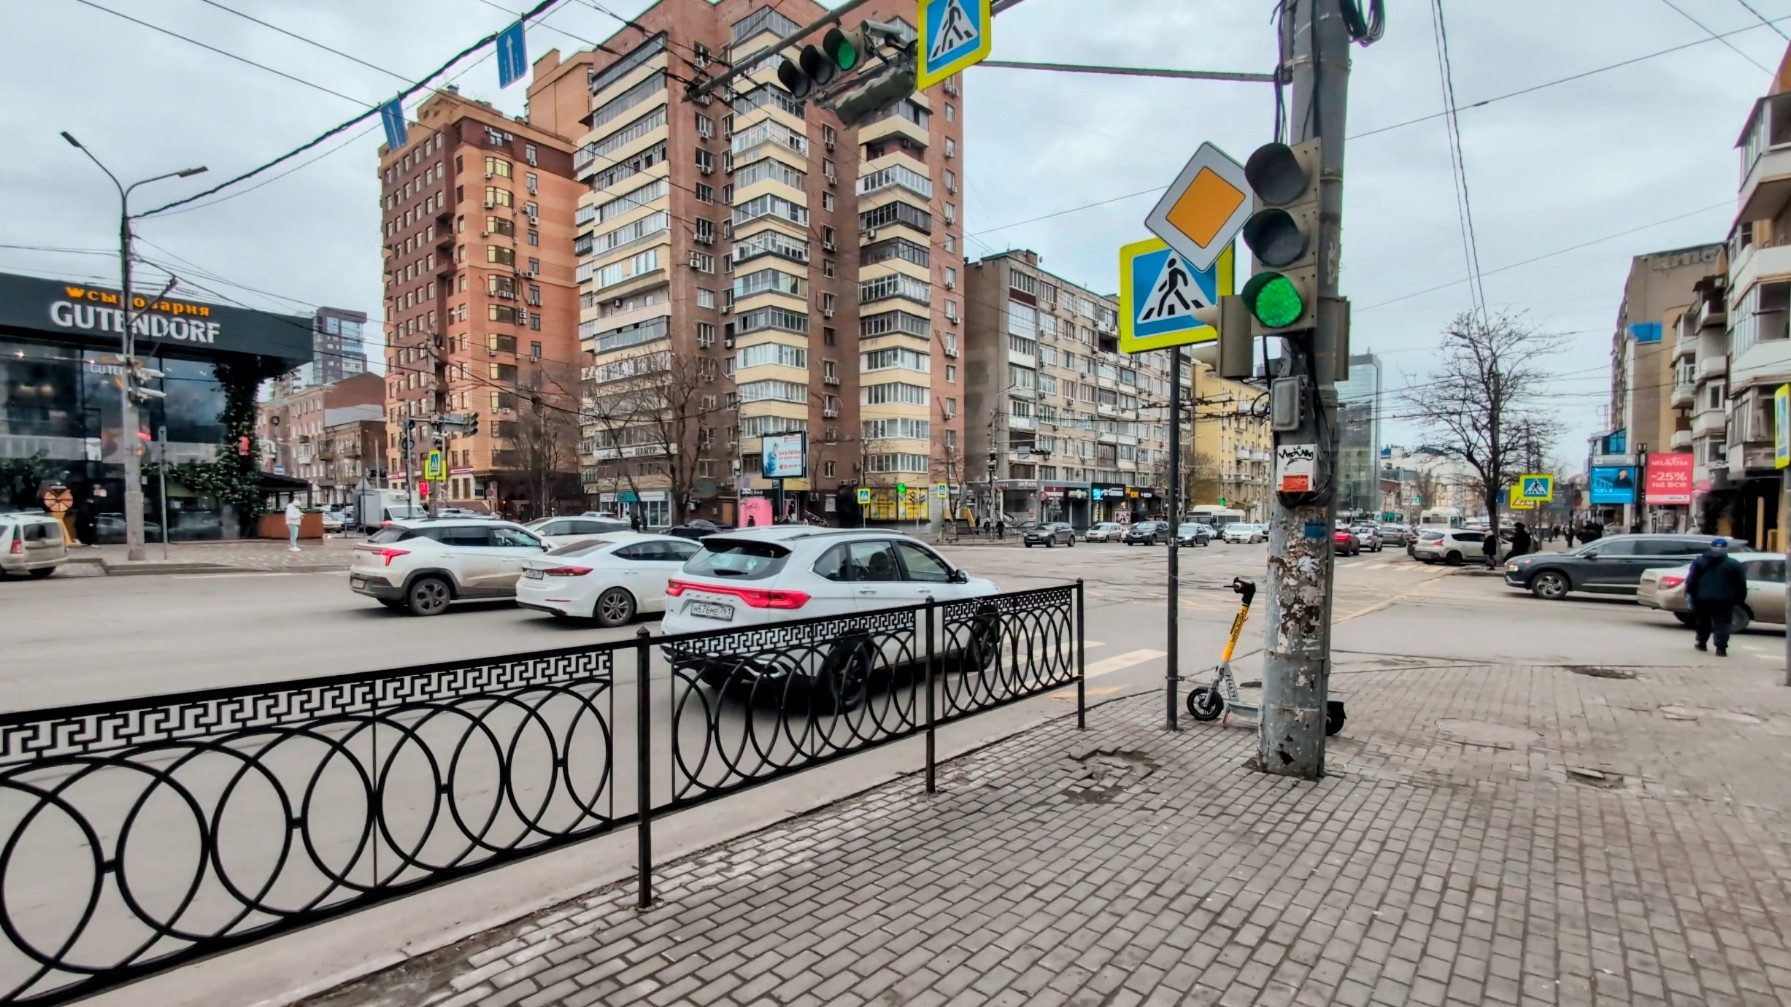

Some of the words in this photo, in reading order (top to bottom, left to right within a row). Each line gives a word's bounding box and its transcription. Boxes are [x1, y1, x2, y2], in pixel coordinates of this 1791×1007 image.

[87, 289, 210, 317] сыоарня
[50, 301, 221, 344] GUTENDORF
[1651, 472, 1687, 481] -25%
